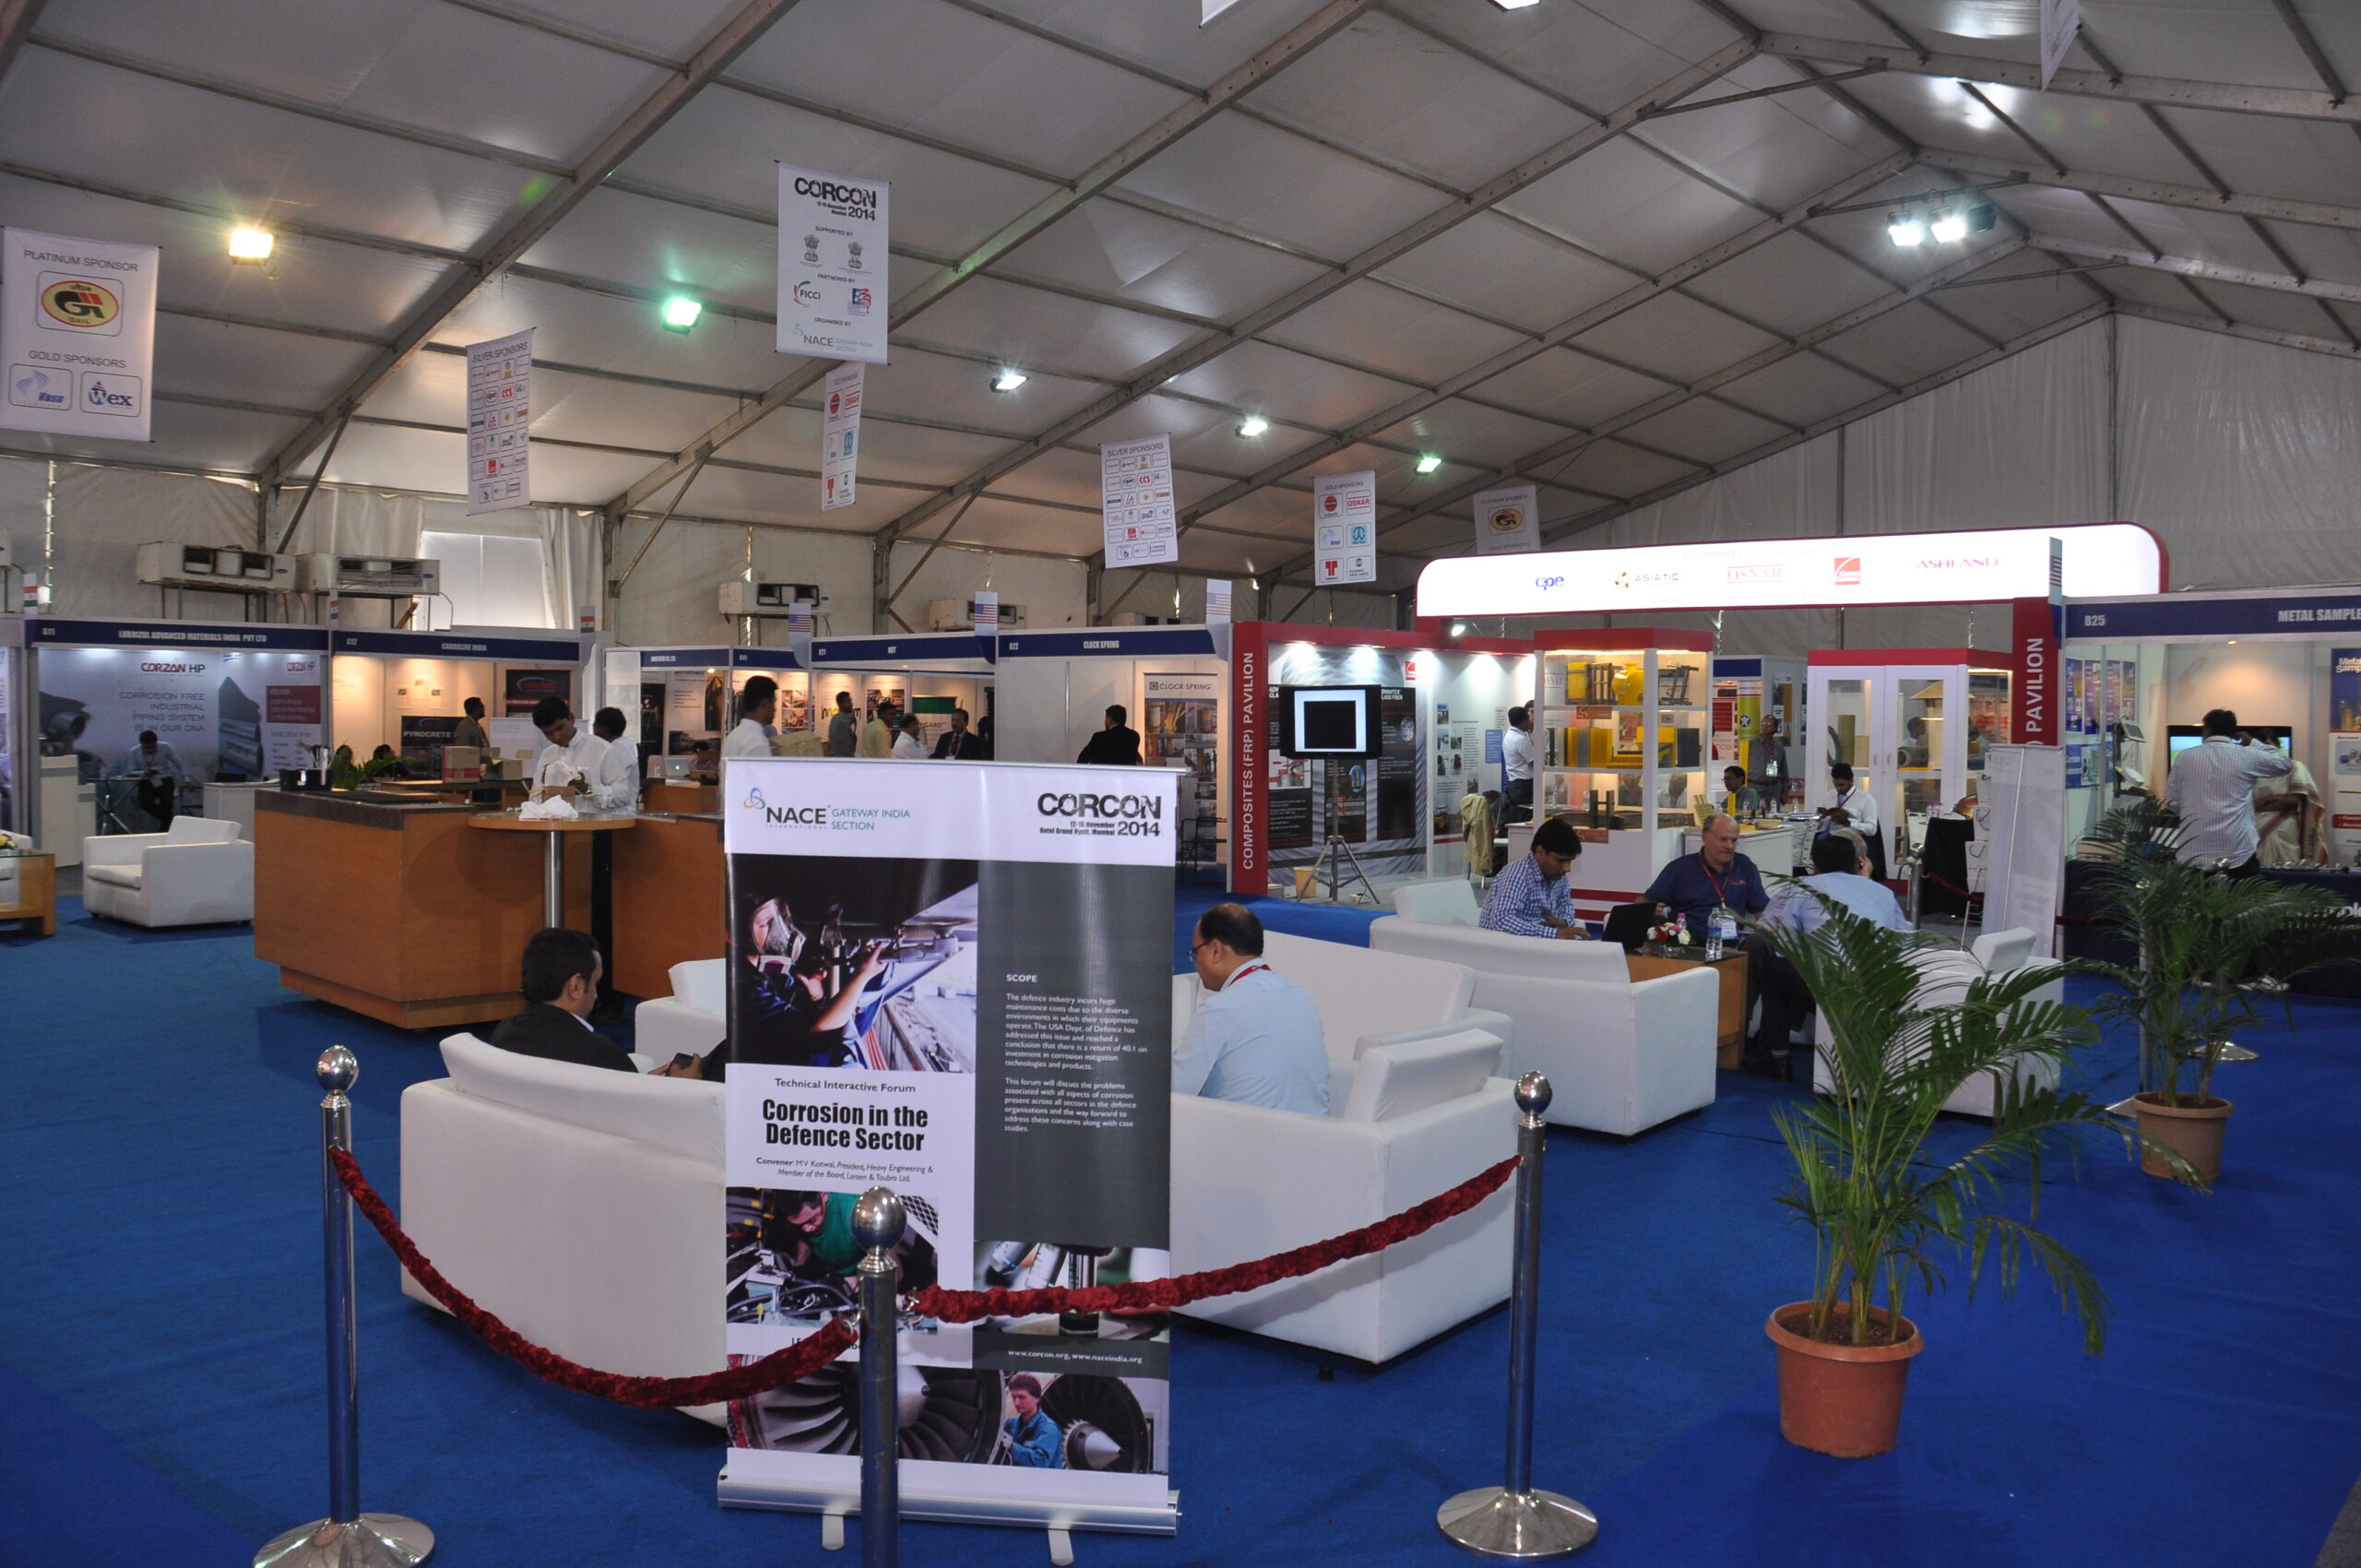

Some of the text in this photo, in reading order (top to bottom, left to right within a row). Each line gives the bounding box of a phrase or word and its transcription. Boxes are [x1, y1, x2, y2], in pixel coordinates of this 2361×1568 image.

[794, 177, 877, 208] CORCON
[848, 206, 876, 221] 2014
[24, 249, 138, 272] PLATINUM SPONSOR
[800, 289, 822, 301] FICCI
[803, 334, 835, 348] NACE
[29, 350, 126, 369] GOLD SPONSORS
[1107, 442, 1164, 457] SILVER SPONSORS
[1347, 499, 1370, 508] OSNAR
[1634, 572, 1679, 583] ASIATIC
[2083, 614, 2106, 627] B25
[2277, 610, 2315, 622] METAL
[151, 631, 185, 641] ADVANCED
[186, 633, 222, 642] MATERIALS
[222, 634, 242, 642] INDIA
[243, 635, 255, 643] PVT
[1083, 640, 1100, 649] CLOCK
[140, 662, 206, 673] CORZAN HP
[1158, 682, 1211, 691] CLOCK SPRING
[2025, 637, 2044, 732] PAVILION
[118, 692, 206, 701] CORROSION FREE
[149, 703, 206, 711] INDUSTRIAL
[132, 713, 206, 722] PIPING SYSTEM
[160, 724, 182, 732] OUR
[184, 724, 206, 732] DNA
[403, 731, 453, 740] PYROCRETE
[1241, 651, 1254, 870] COMPOSITES (FRP) PAVILION
[1038, 792, 1161, 819] CORCON
[765, 807, 910, 825] NACE GATEWAY INDIA
[831, 822, 875, 830] SECTION
[1117, 821, 1160, 837] 2014
[1021, 994, 1047, 1003] defence
[1049, 996, 1075, 1004] industry
[1098, 998, 1116, 1006] huge
[1005, 1023, 1033, 1031] operate.
[1065, 1025, 1084, 1033] Dept.
[1050, 1052, 1083, 1061] corrosion
[1085, 1053, 1118, 1063] mitigation
[1004, 1060, 1047, 1068] technologies
[1062, 1062, 1092, 1070] products.
[775, 1078, 916, 1093] Technical Interactive Forum
[1004, 1077, 1019, 1086] This
[1056, 1080, 1079, 1088] discuss
[763, 1099, 928, 1128] Corrosion in the
[1083, 1119, 1101, 1128] along
[1102, 1119, 1117, 1127] with
[766, 1123, 925, 1151] Defence Sector
[867, 1163, 887, 1172] Heavy
[888, 1164, 926, 1174] Engineering
[777, 1169, 804, 1177] Member
[806, 1170, 814, 1178] of
[846, 1172, 867, 1181] Larsen
[1008, 1349, 1143, 1364] www.corcon.org, www.naceindia.org
